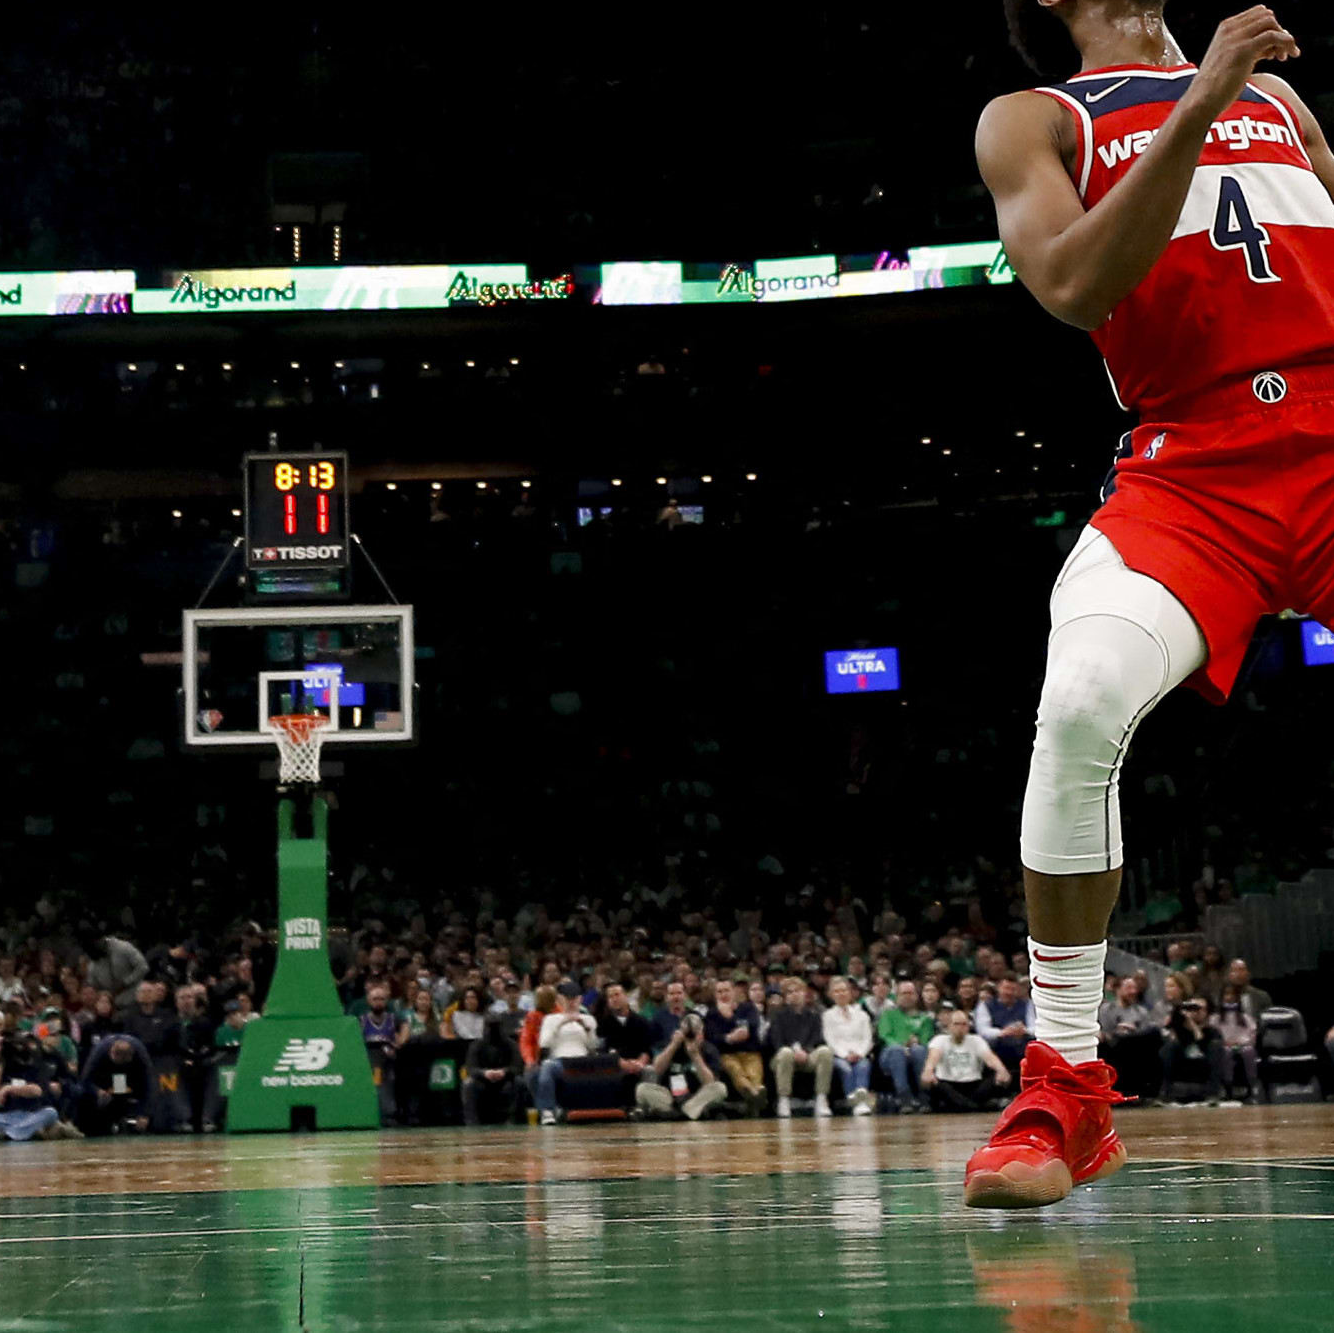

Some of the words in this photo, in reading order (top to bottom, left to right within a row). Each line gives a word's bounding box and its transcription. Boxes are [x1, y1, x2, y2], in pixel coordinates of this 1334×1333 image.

[1097, 116, 1294, 168] wangton
[1208, 174, 1281, 283] 4
[169, 274, 297, 305] Algorand
[716, 264, 839, 299] Algorand
[275, 462, 335, 491] 8:13
[283, 493, 330, 535] 11
[277, 546, 343, 560] TISSOT
[837, 660, 886, 675] ULTRA
[284, 918, 321, 936] VISTA
[285, 936, 321, 950] PRINT
[261, 1076, 288, 1086] new
[290, 1074, 343, 1086] balance
